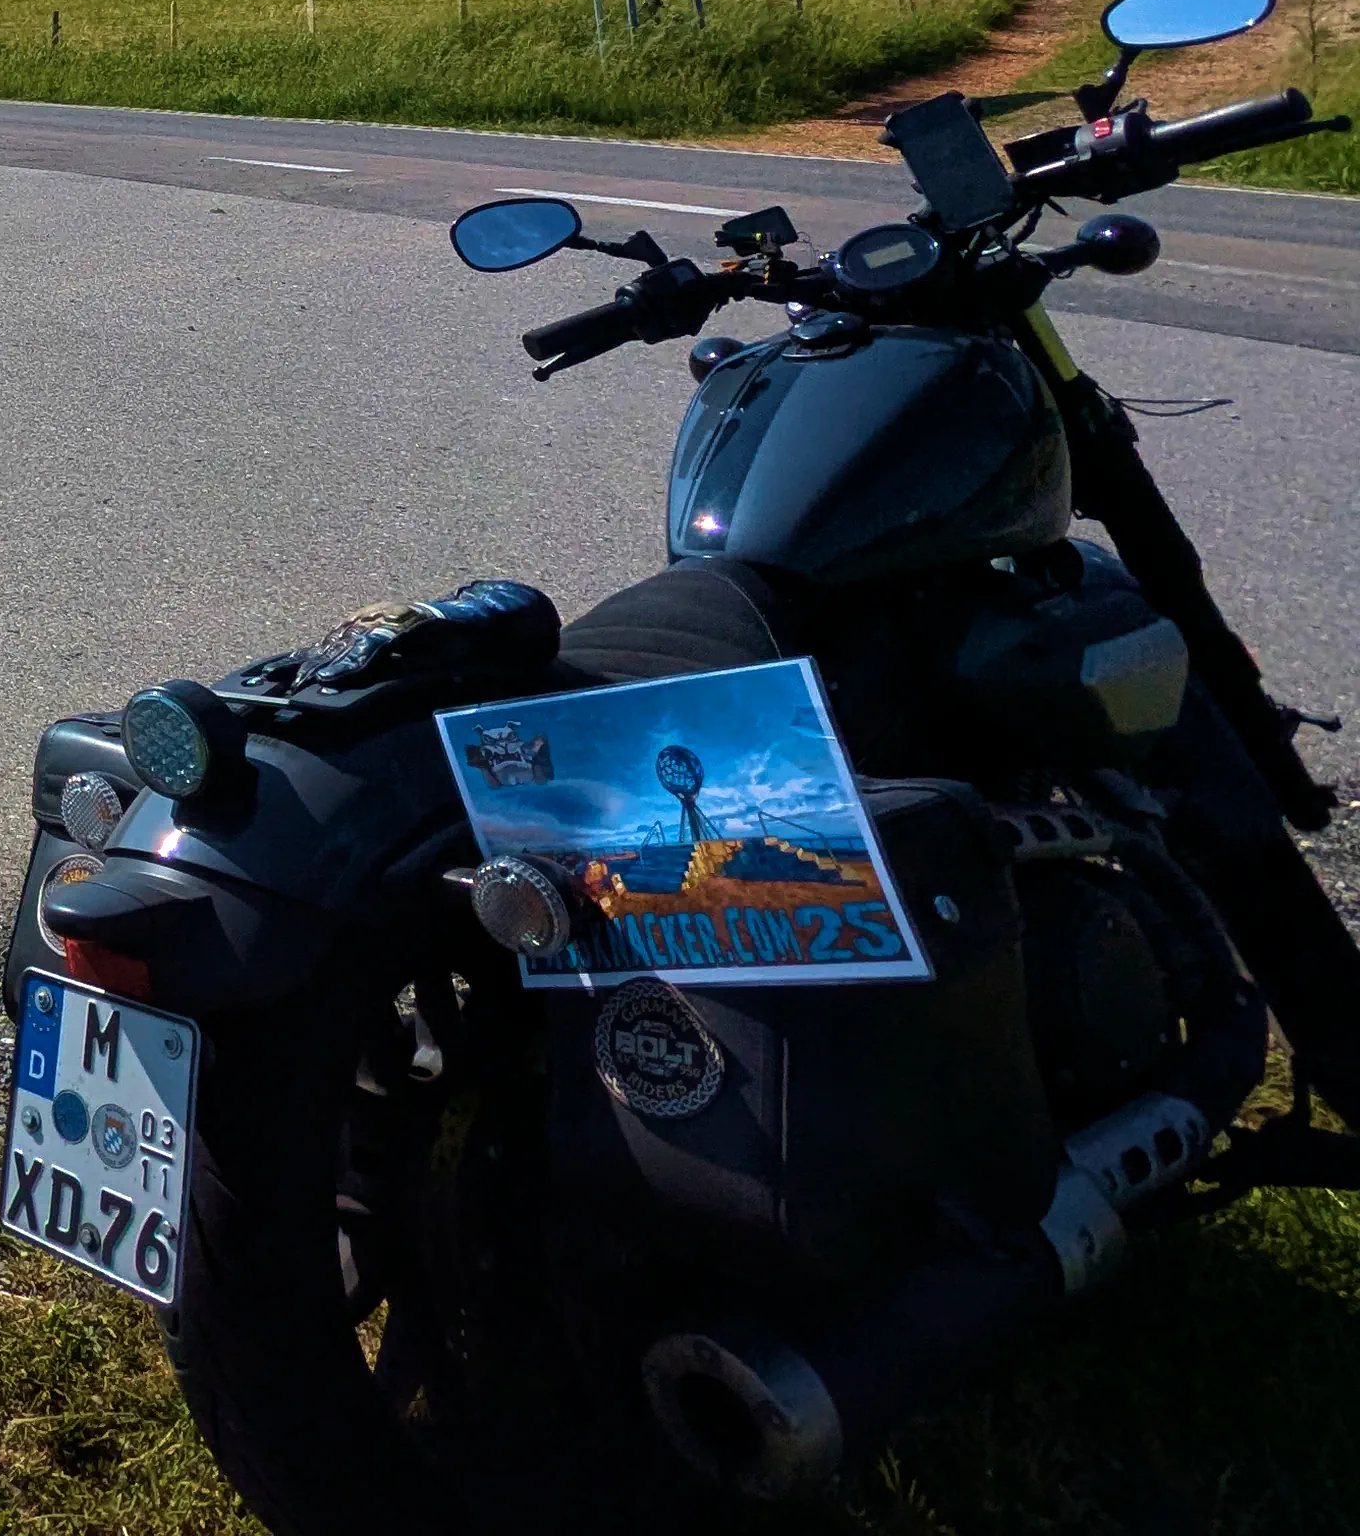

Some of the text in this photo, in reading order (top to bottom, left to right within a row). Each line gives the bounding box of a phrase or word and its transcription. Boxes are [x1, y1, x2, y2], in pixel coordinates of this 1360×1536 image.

[795, 901, 902, 962] 25
[83, 998, 121, 1082] M
[614, 1029, 700, 1066] BOLT
[28, 1050, 45, 1080] D
[140, 1108, 175, 1149] 03
[140, 1157, 169, 1200] 11
